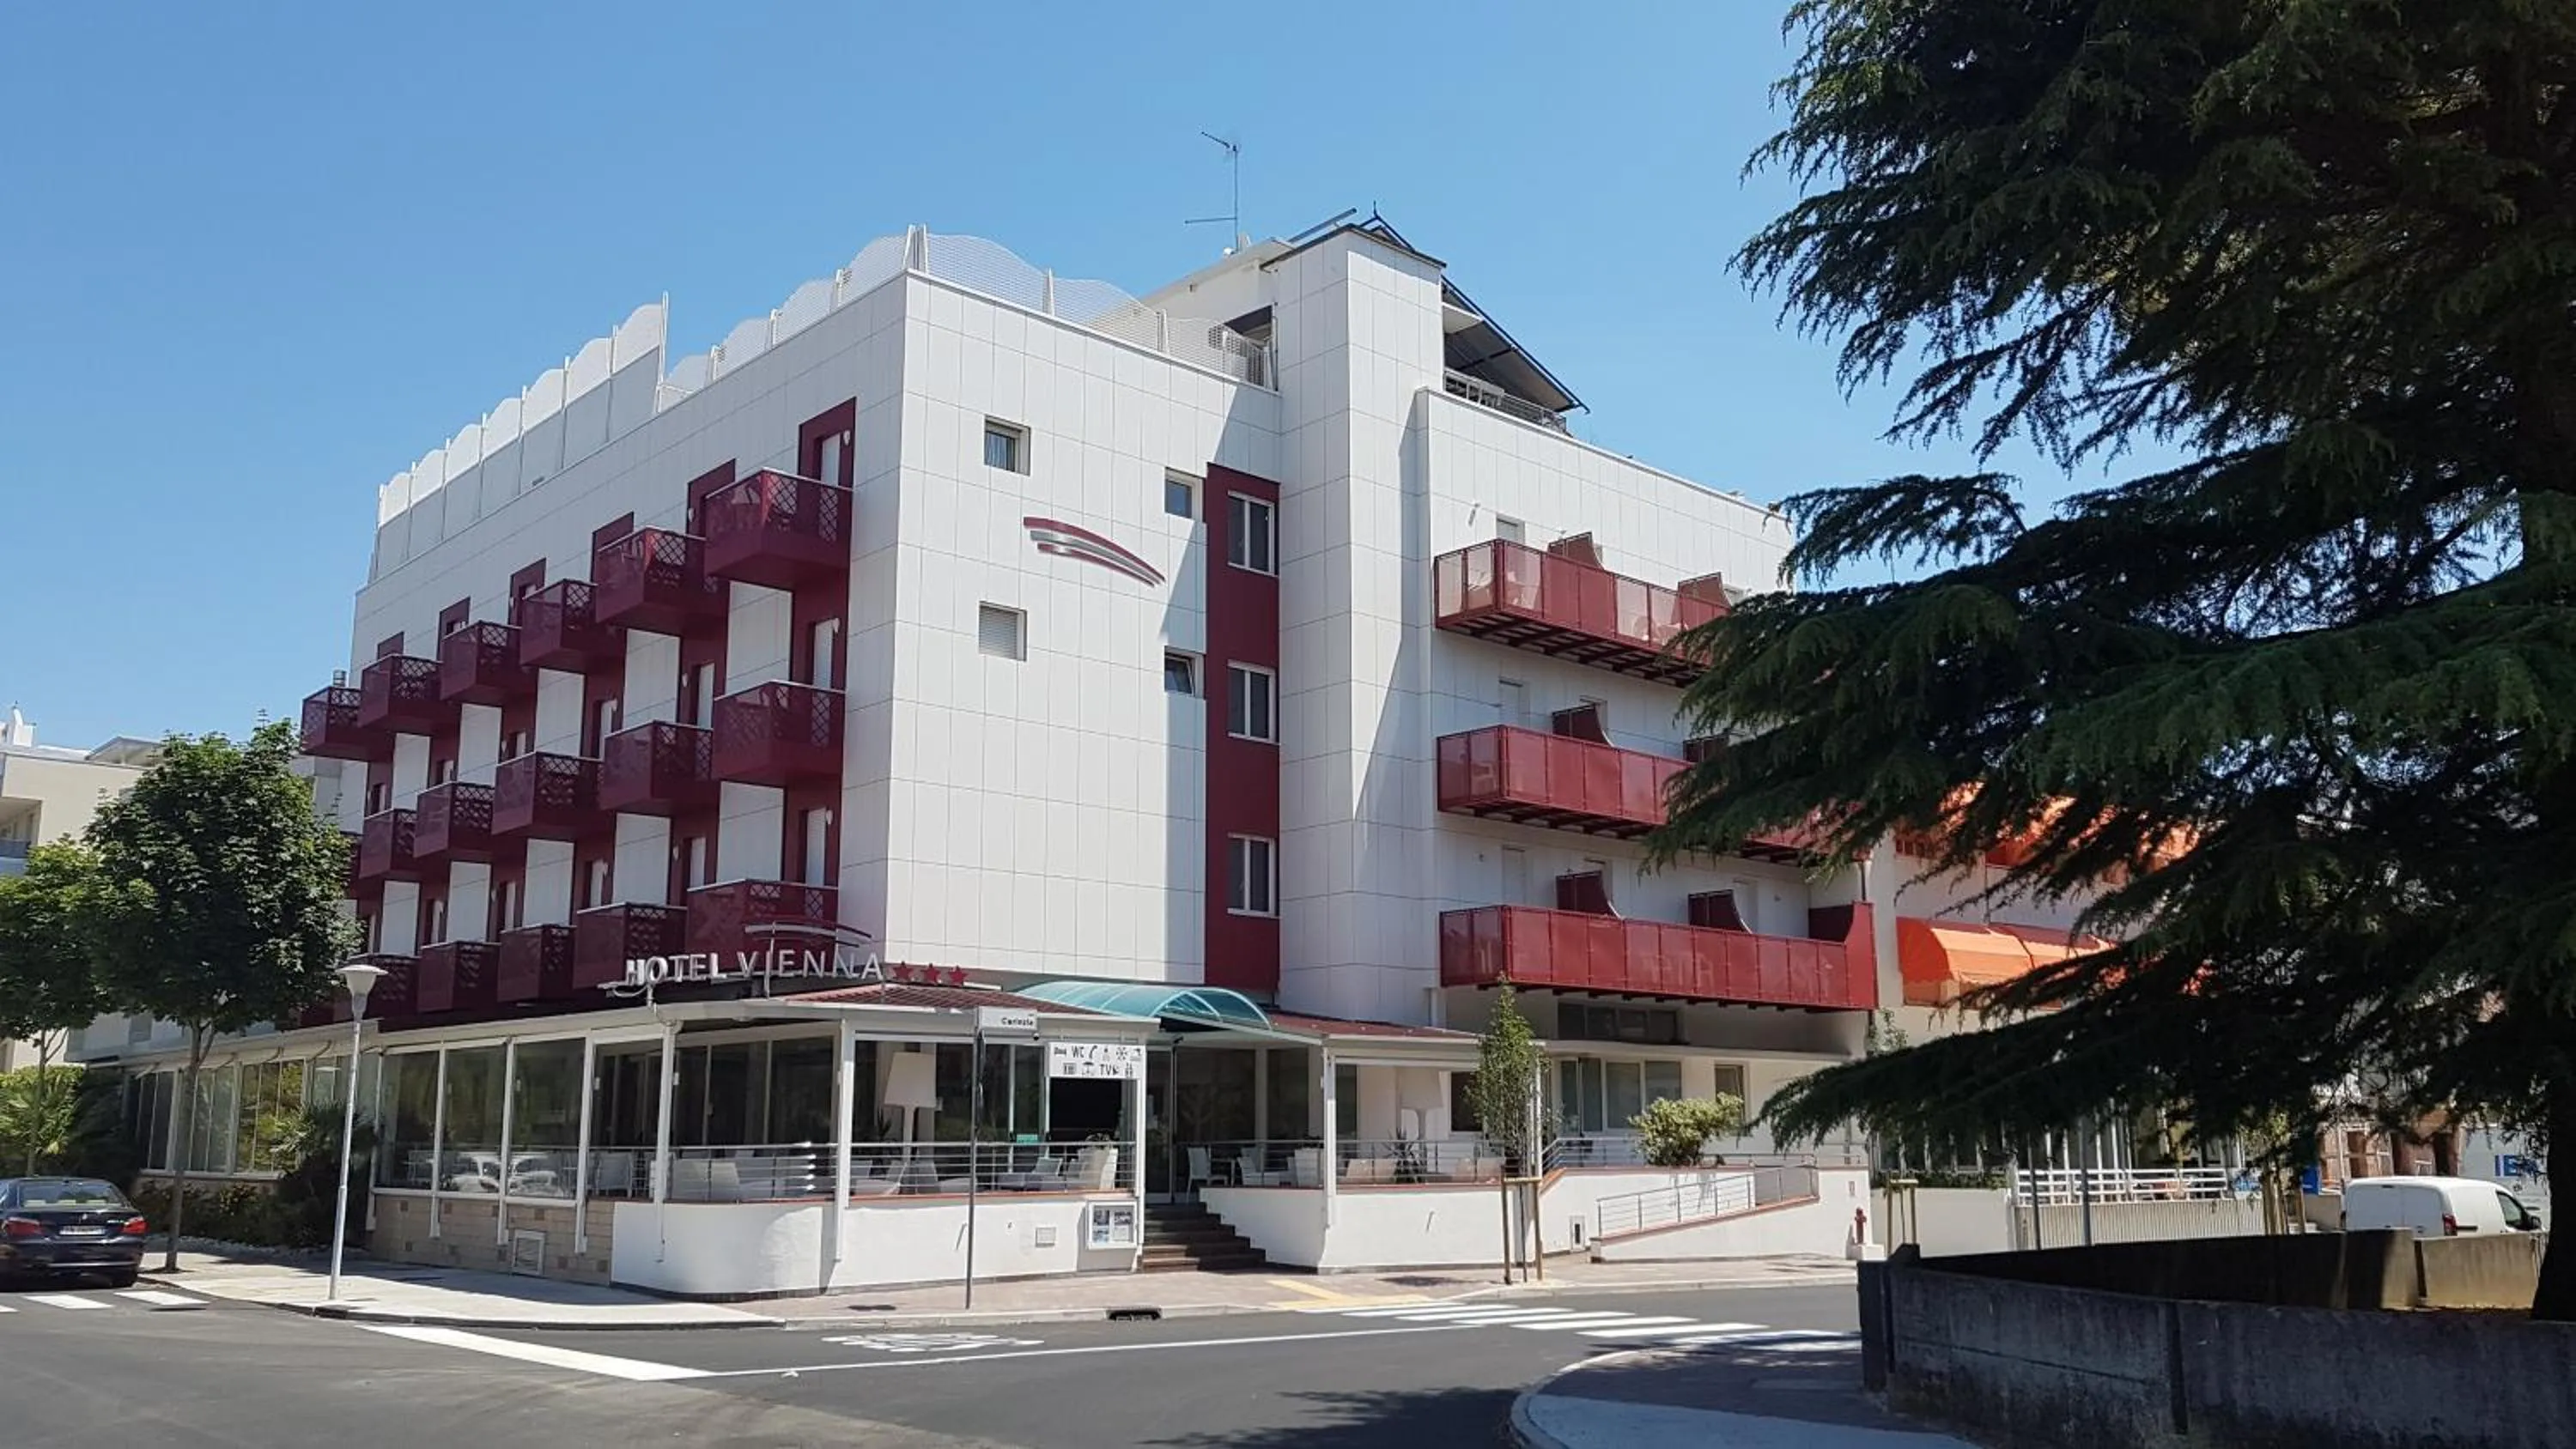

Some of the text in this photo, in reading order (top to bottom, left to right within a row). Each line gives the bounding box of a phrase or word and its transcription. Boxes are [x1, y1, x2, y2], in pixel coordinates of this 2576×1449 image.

[625, 949, 884, 985] HOTEL VIENNA
[1071, 1045, 1084, 1058] WC
